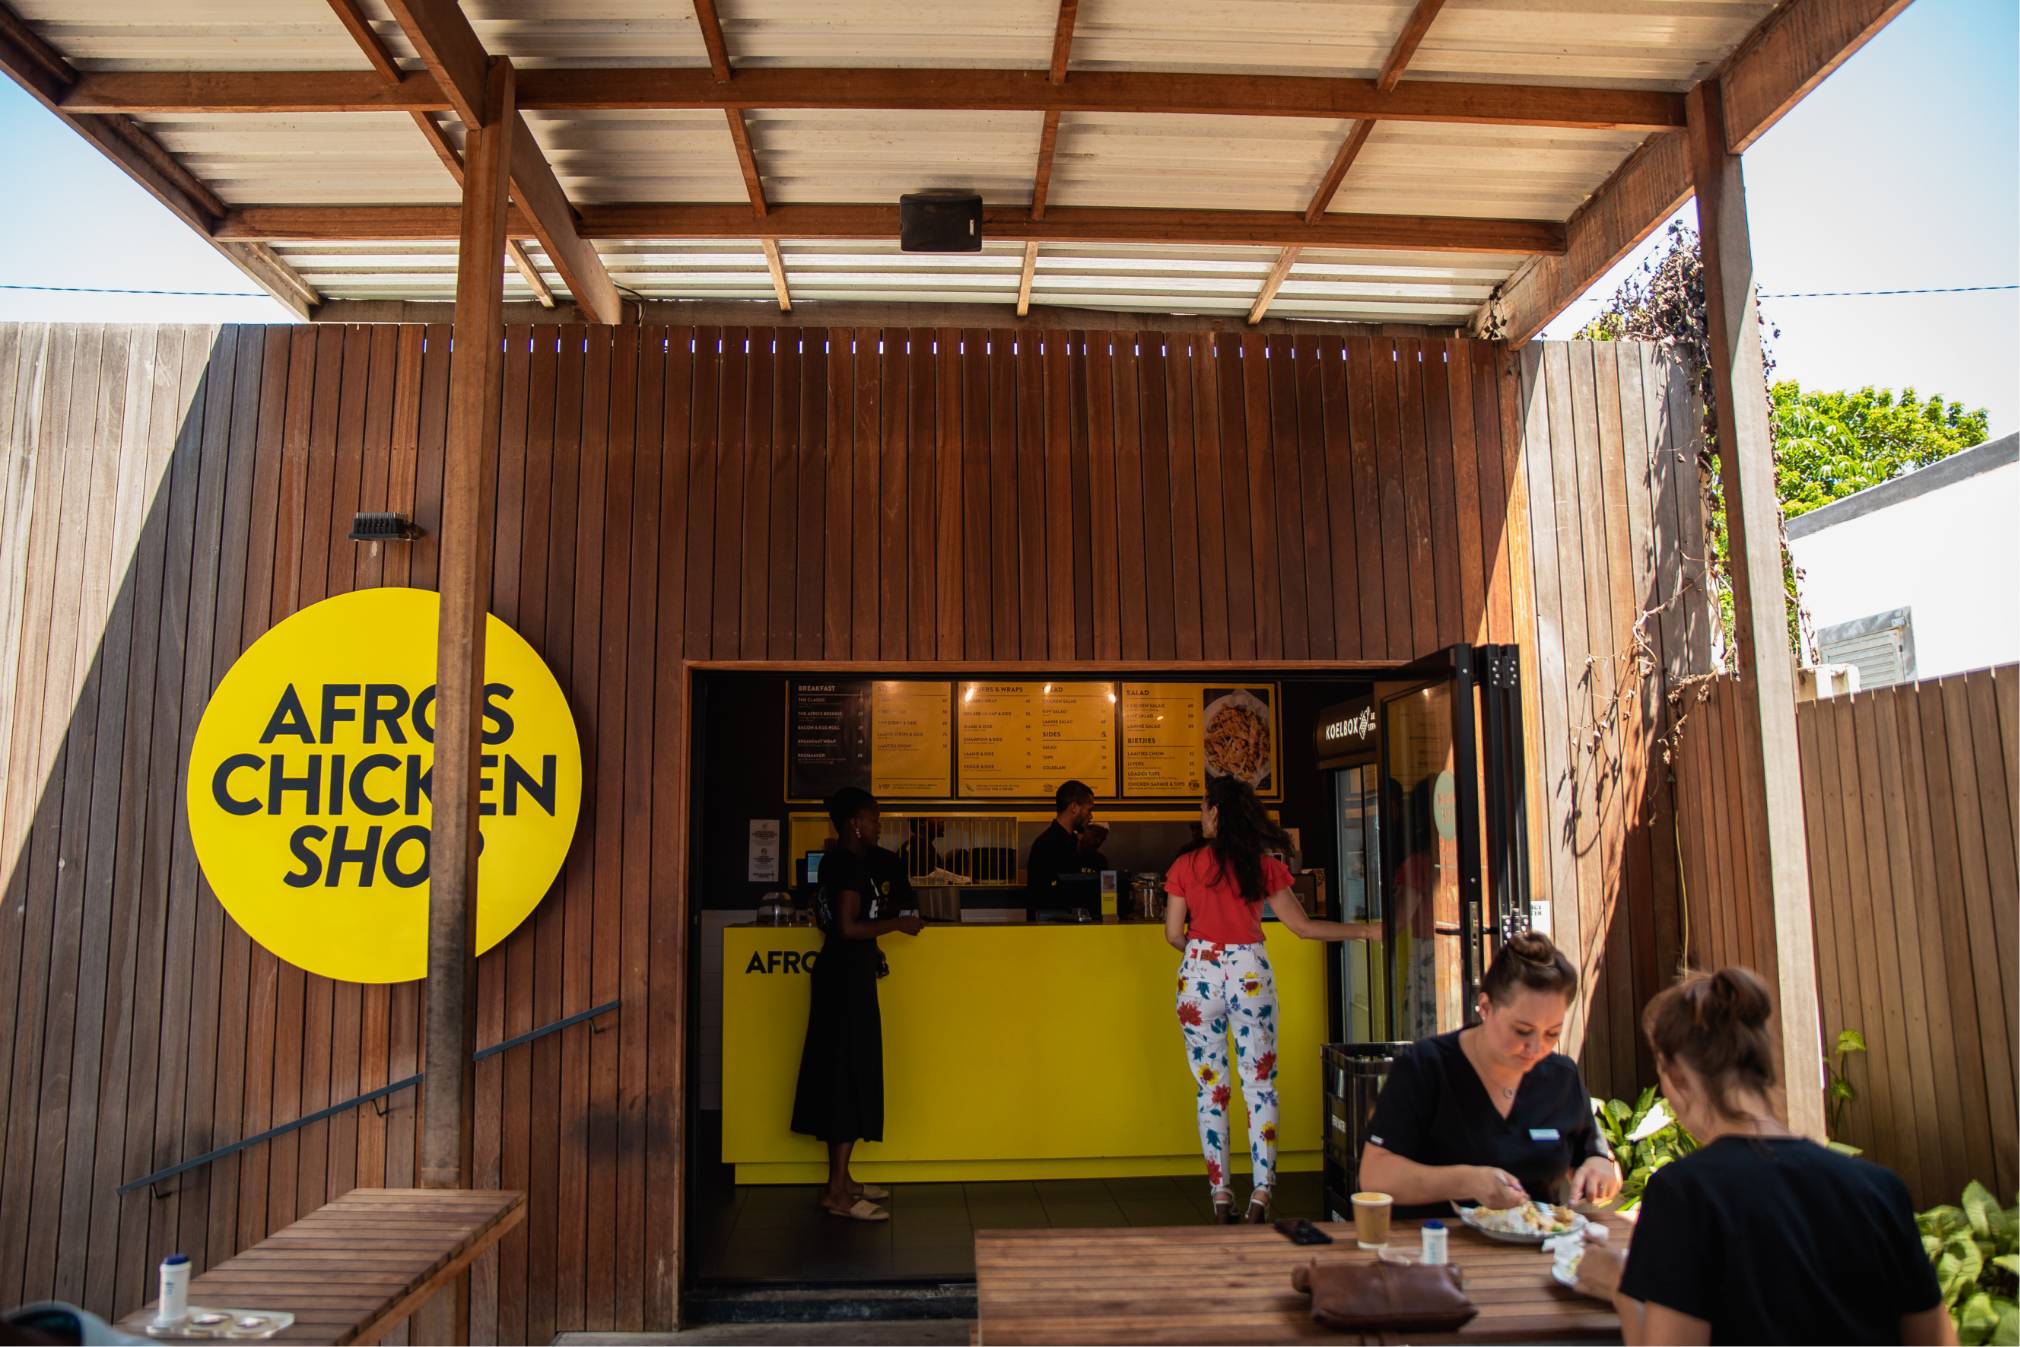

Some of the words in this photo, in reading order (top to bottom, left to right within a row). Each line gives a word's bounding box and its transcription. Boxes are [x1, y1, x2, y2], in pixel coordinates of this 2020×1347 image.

[1326, 717, 1359, 740] KOELBOX
[211, 752, 557, 817] CHICKEN
[283, 825, 485, 889] SHO
